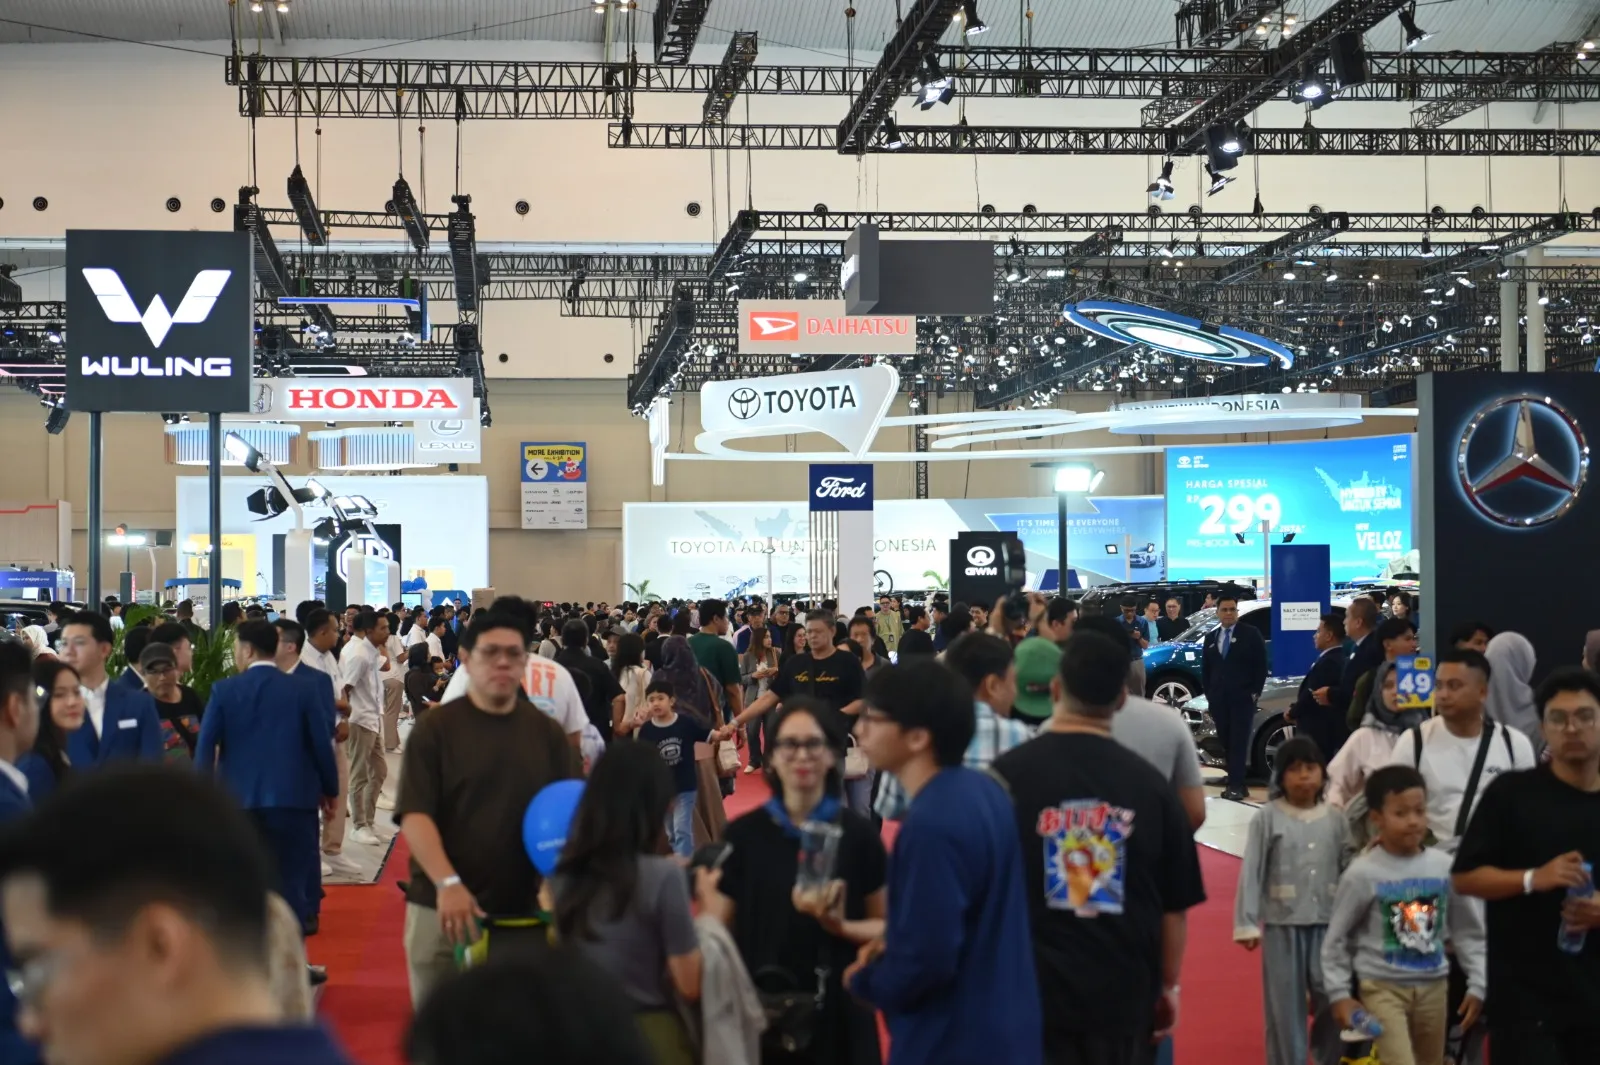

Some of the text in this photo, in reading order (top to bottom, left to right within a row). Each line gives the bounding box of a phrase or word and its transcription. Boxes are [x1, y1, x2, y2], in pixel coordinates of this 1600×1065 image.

[806, 317, 908, 335] DAIHATSU
[81, 355, 232, 377] WULING
[288, 388, 458, 409] HONDA
[764, 385, 856, 414] TOYOTA
[419, 442, 475, 450] LEXUS
[815, 476, 867, 498] Ford
[1186, 479, 1268, 488] HARGA SPESIAL
[1017, 519, 1033, 527] IT'S
[1035, 519, 1055, 527] TIME
[1076, 518, 1119, 526] EVERYONE
[1198, 493, 1282, 535] 299
[671, 541, 735, 554] TOYOTA
[1355, 530, 1403, 551] VELOZ
[965, 567, 997, 576] GWM
[1399, 672, 1431, 694] 49
